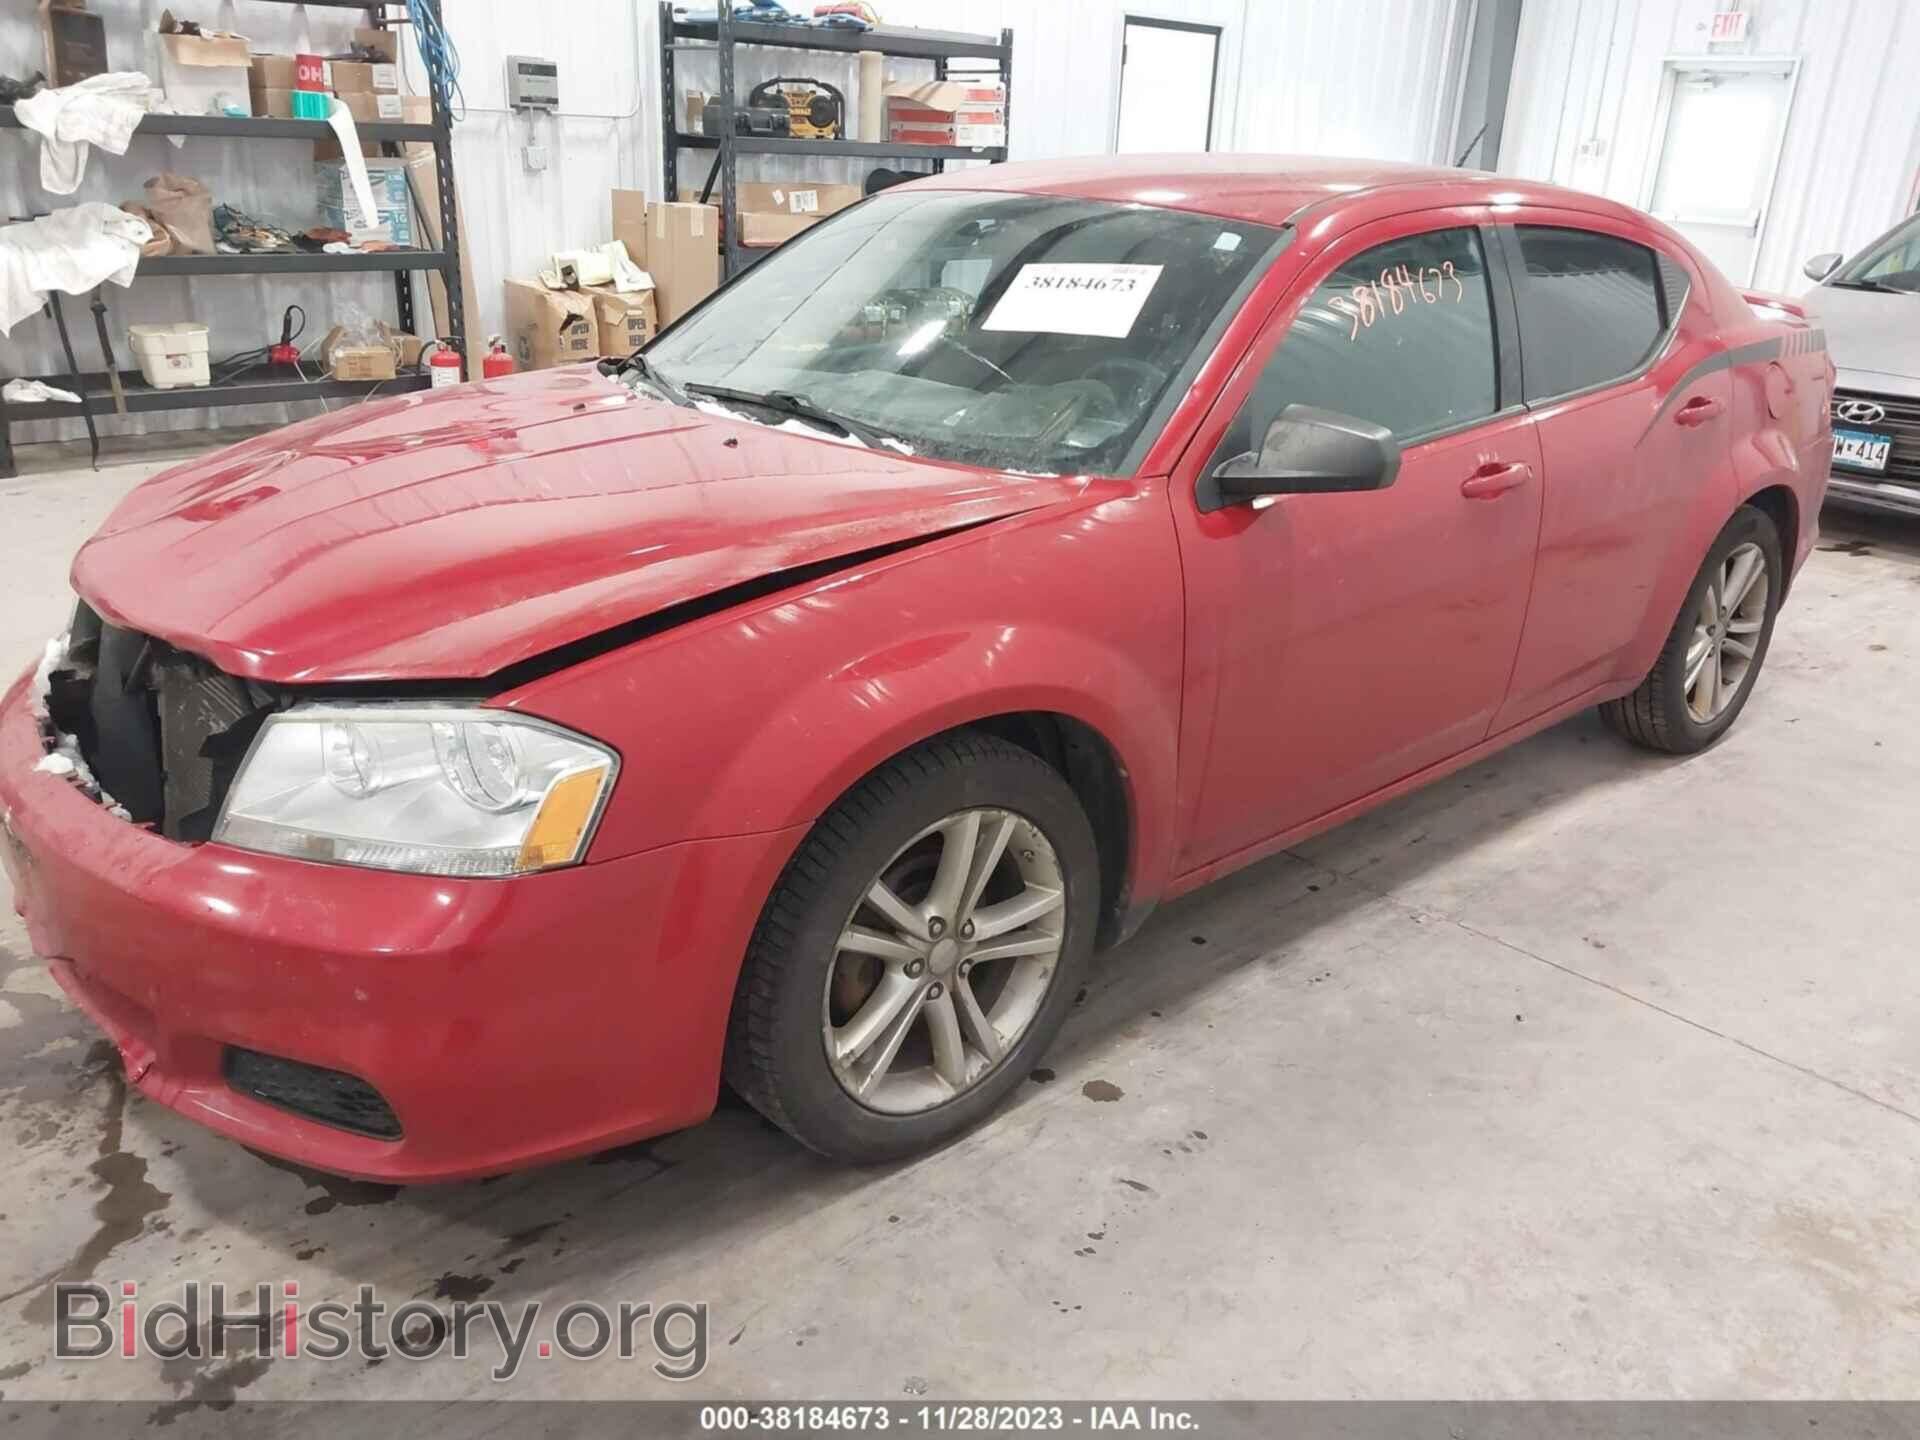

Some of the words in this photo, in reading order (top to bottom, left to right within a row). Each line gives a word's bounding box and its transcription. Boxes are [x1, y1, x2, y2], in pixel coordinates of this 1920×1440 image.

[1712, 13, 1742, 37] EXIT
[1025, 275, 1137, 292] 38184673
[1328, 260, 1463, 341] 38184673
